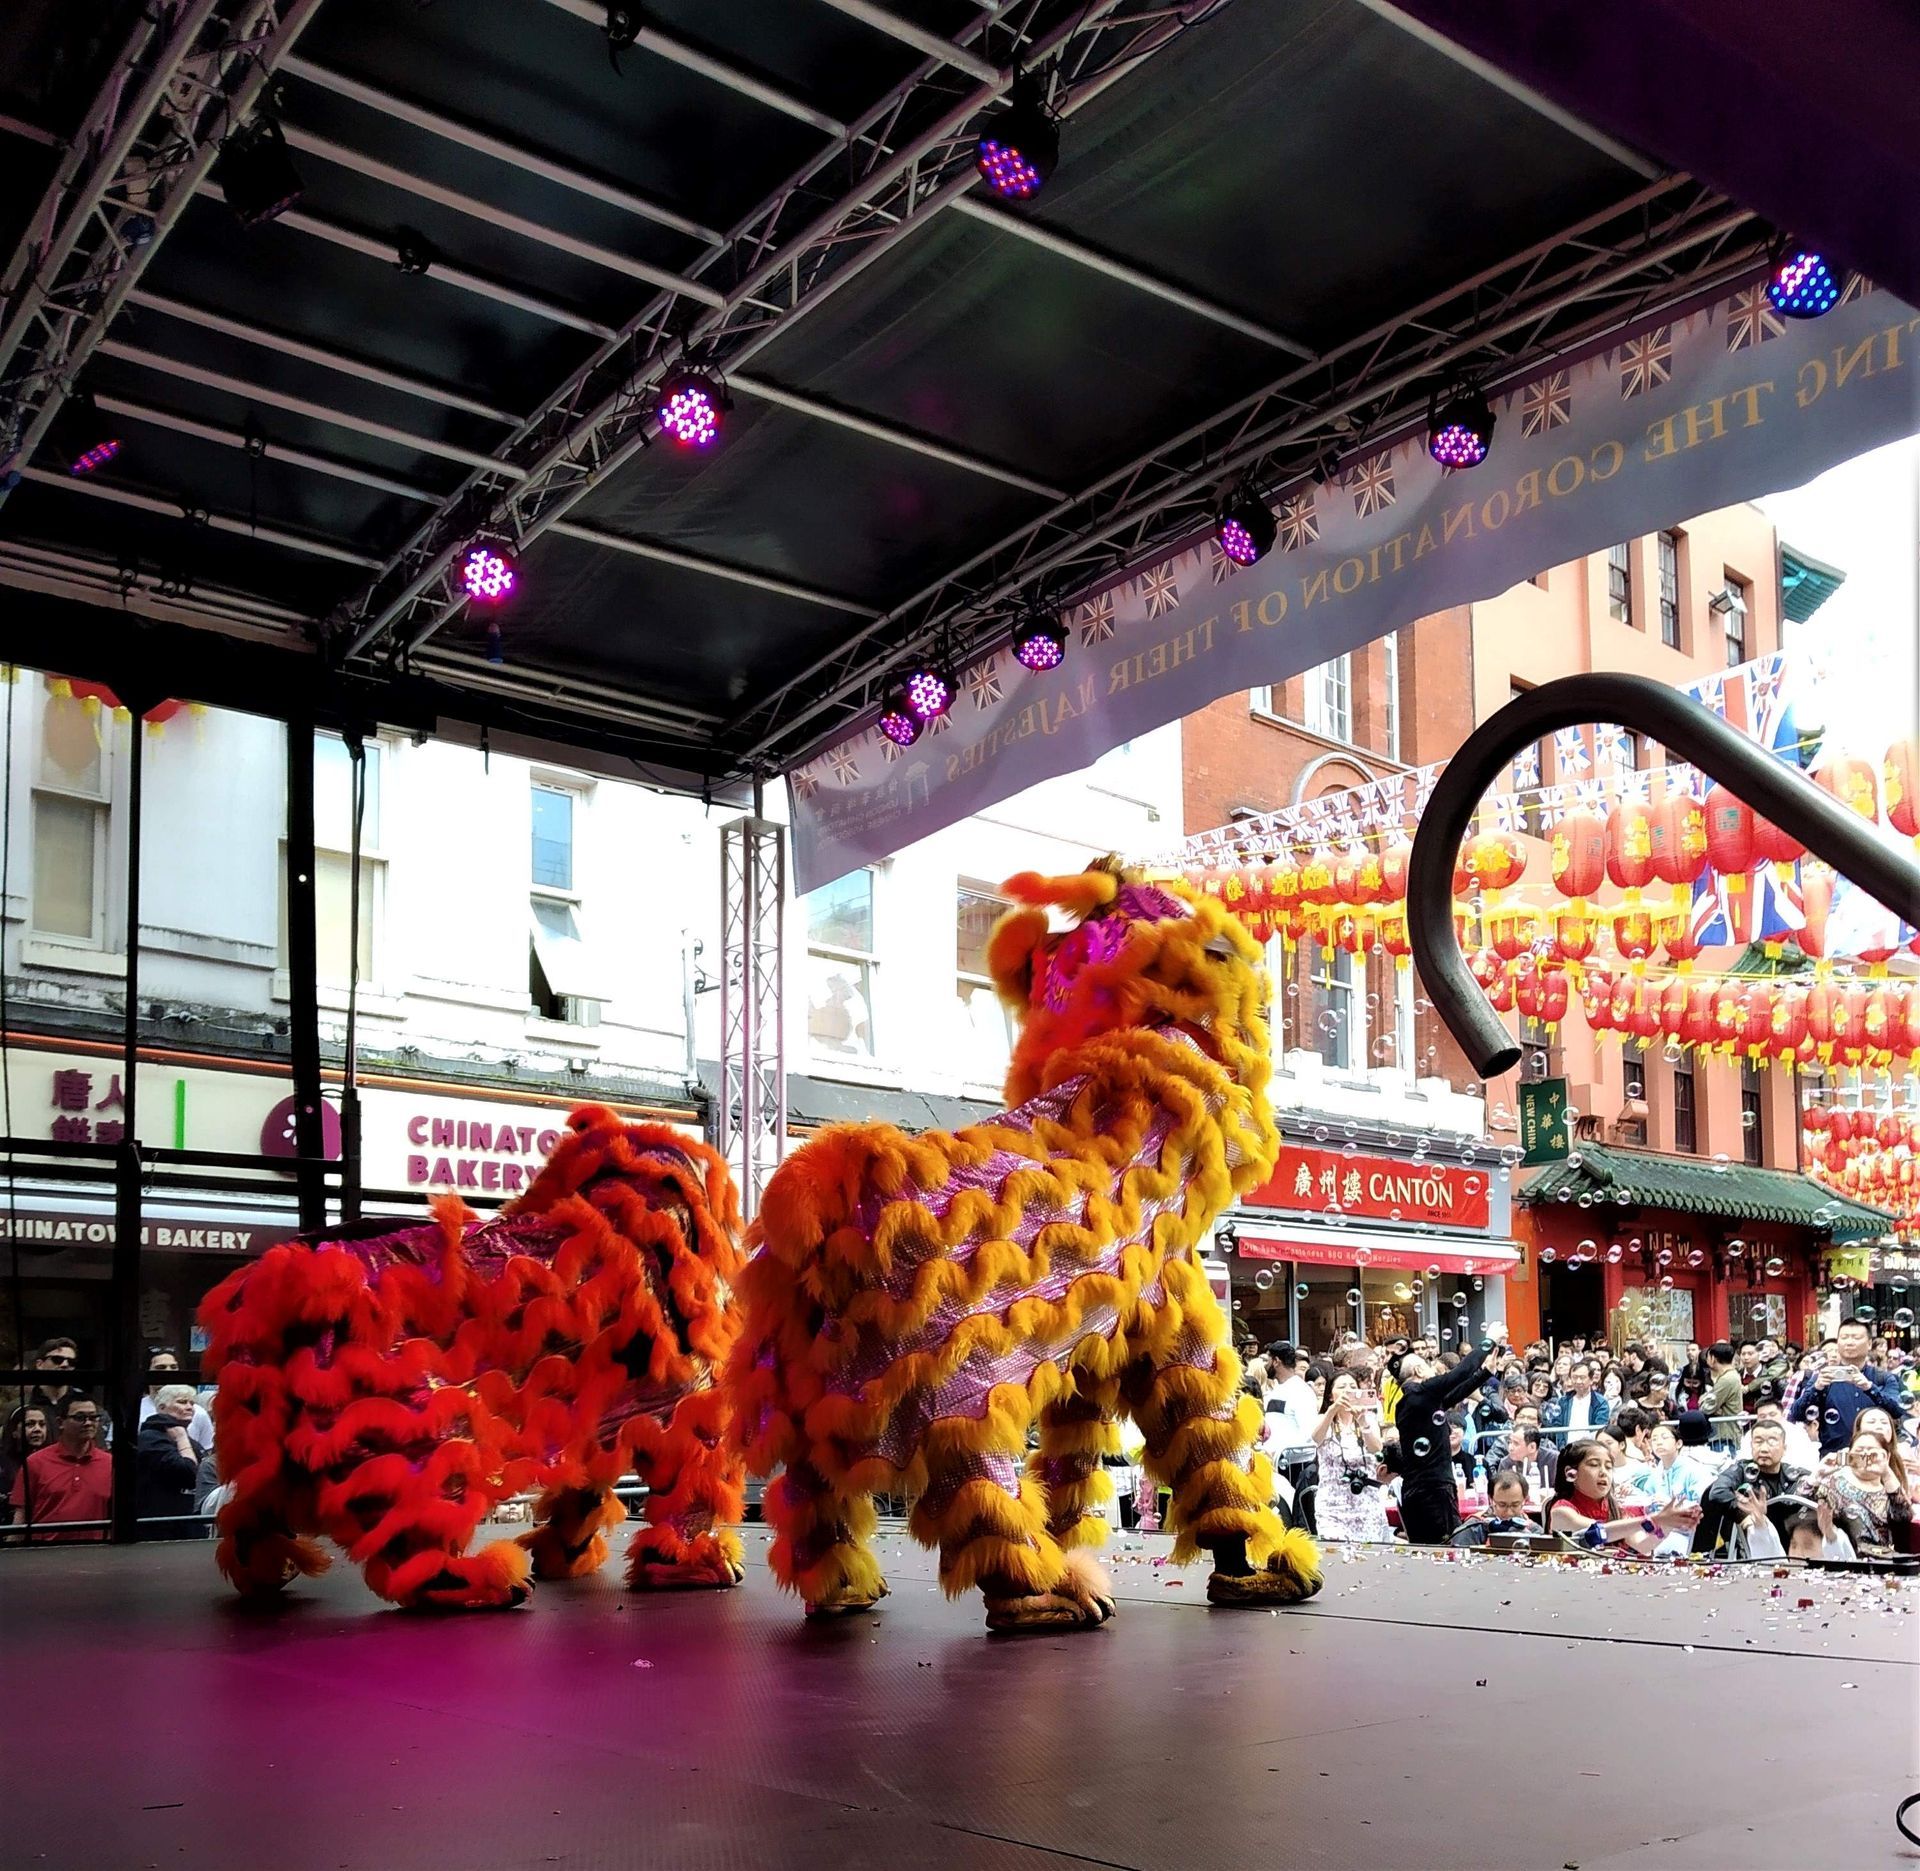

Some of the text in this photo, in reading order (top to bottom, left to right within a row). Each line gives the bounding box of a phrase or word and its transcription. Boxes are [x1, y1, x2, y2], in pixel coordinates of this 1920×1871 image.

[407, 1115, 572, 1155] CHINATO
[1526, 1094, 1537, 1151] NEW CHINA
[1369, 1173, 1453, 1208] CANTON
[156, 1227, 251, 1250] BAKERY
